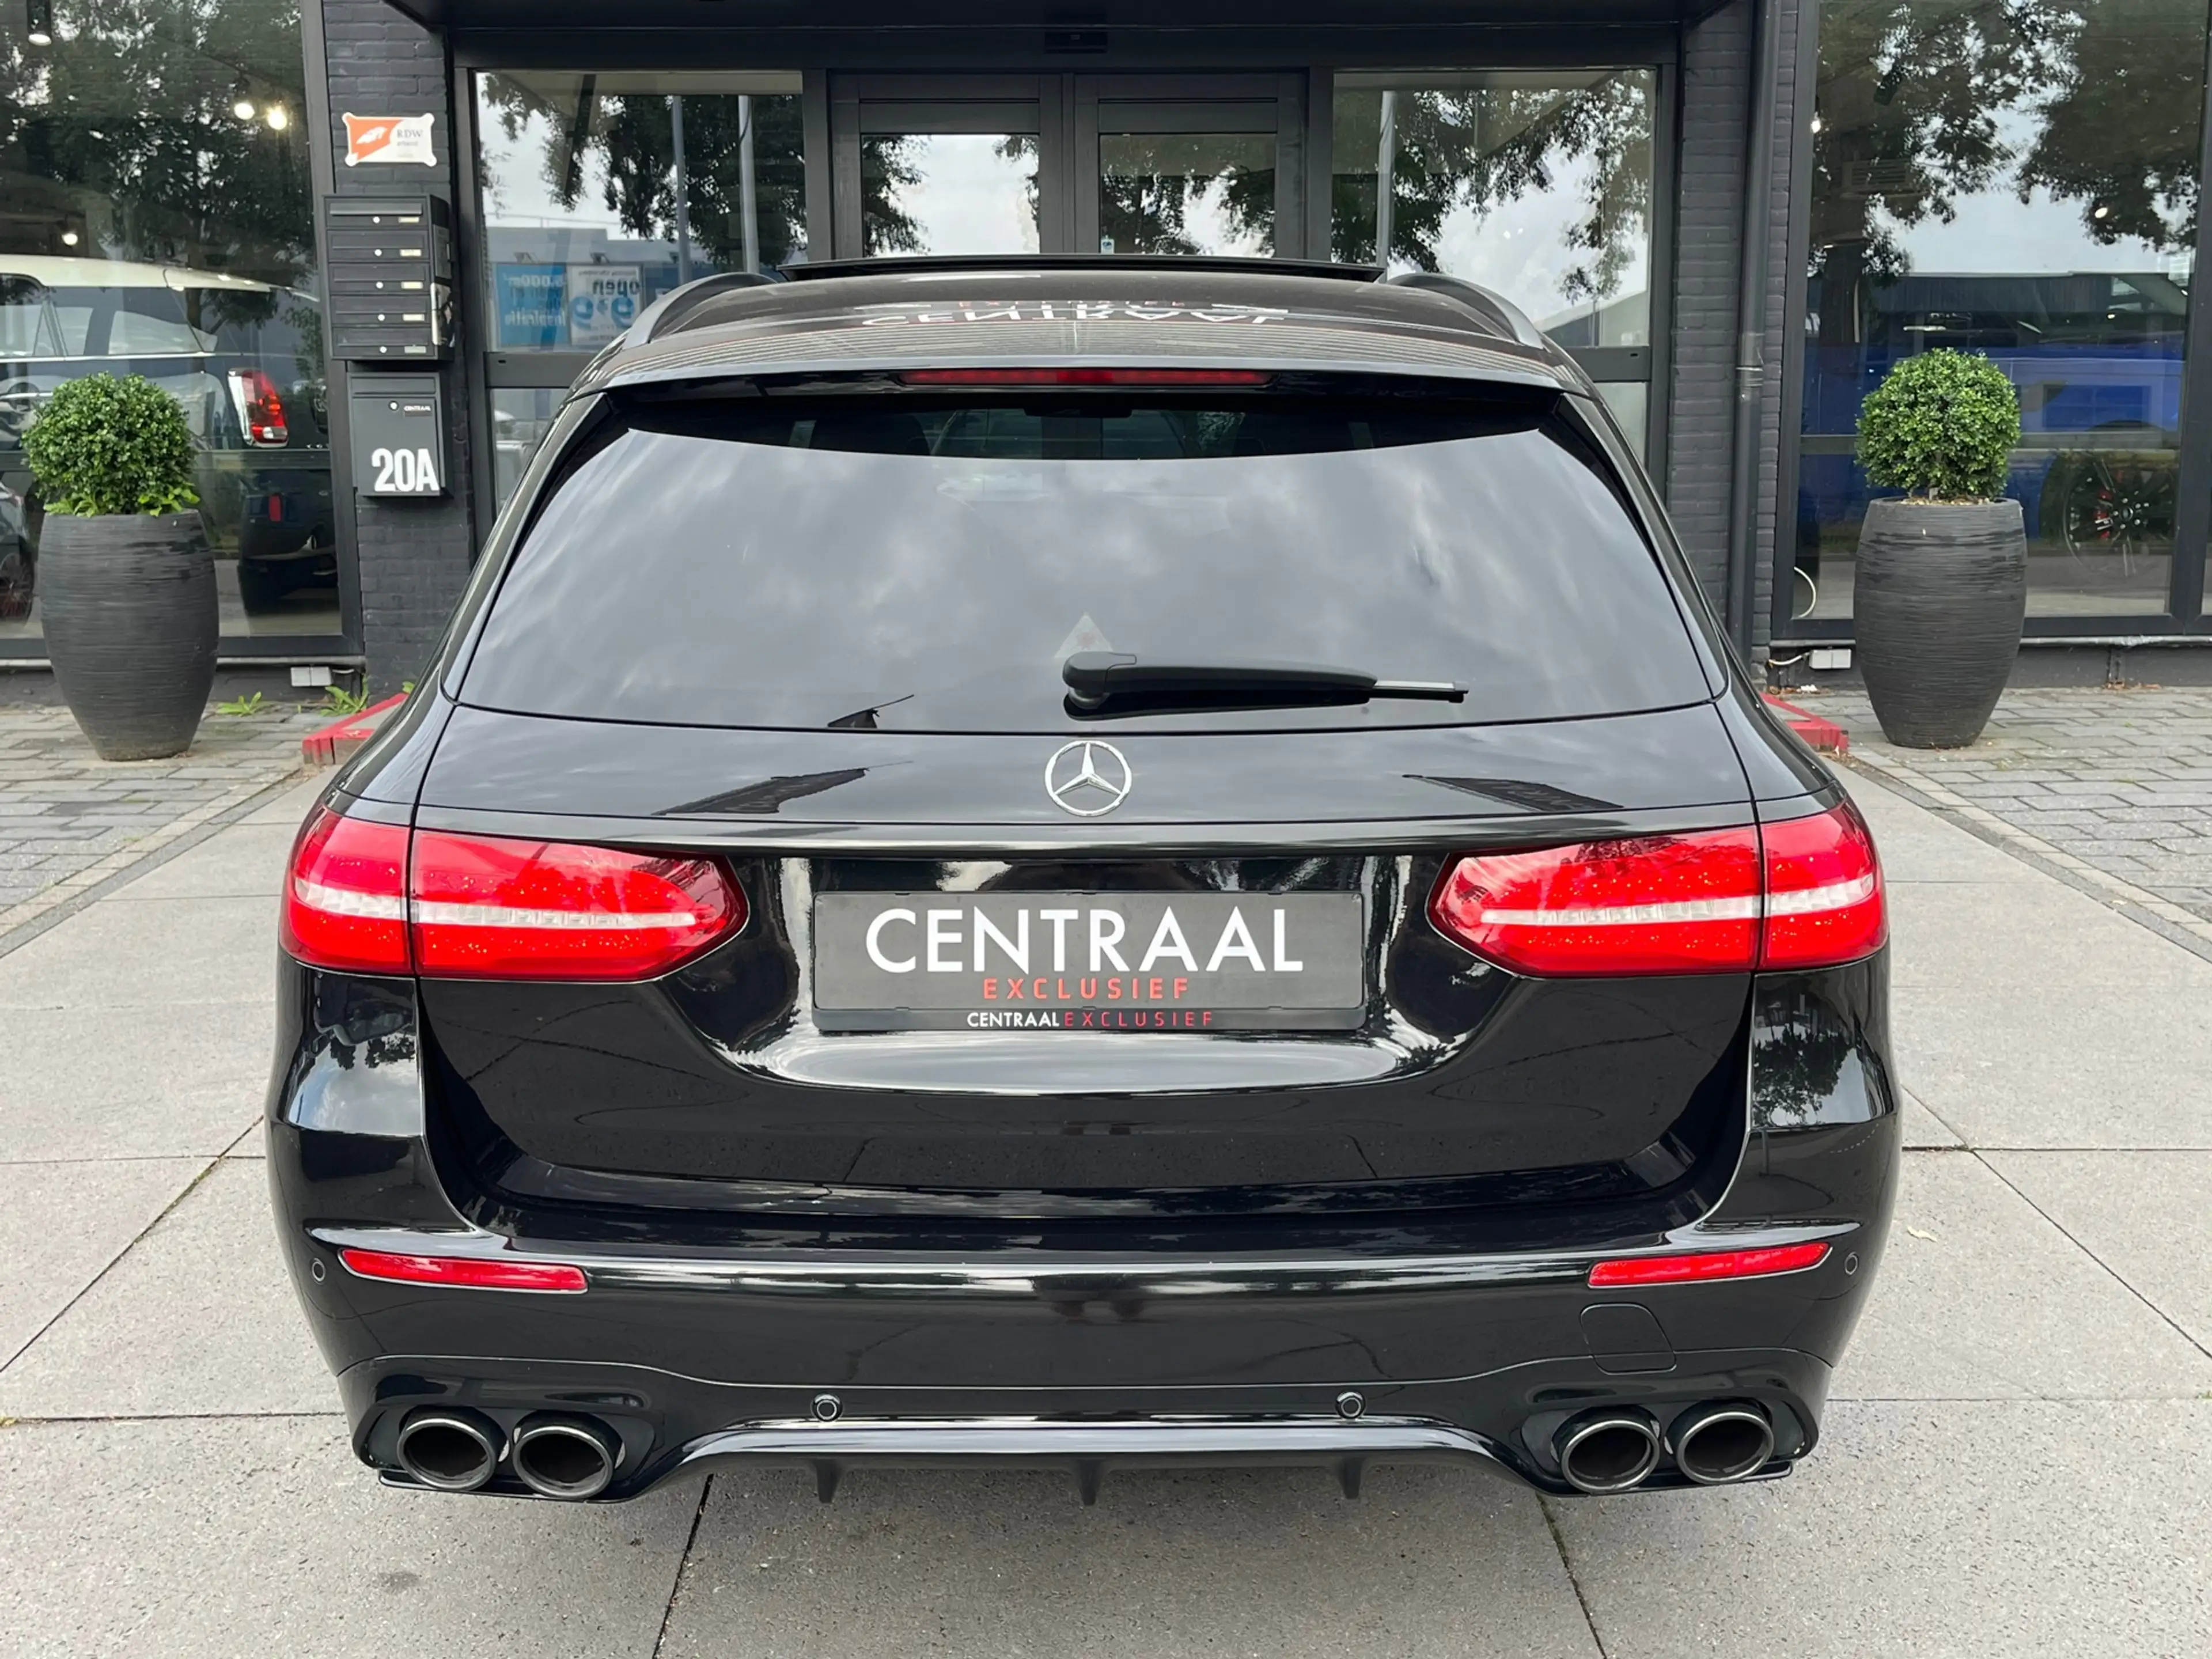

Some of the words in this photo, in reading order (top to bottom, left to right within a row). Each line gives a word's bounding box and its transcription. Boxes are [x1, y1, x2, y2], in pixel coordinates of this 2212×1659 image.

[372, 448, 440, 492] 20A
[865, 906, 1304, 975] CENTRAAL
[983, 978, 1190, 999] EXCLUSIEF
[967, 1012, 1060, 1028] CENTRAAL
[1064, 1012, 1214, 1027] EXCLUSIEF
